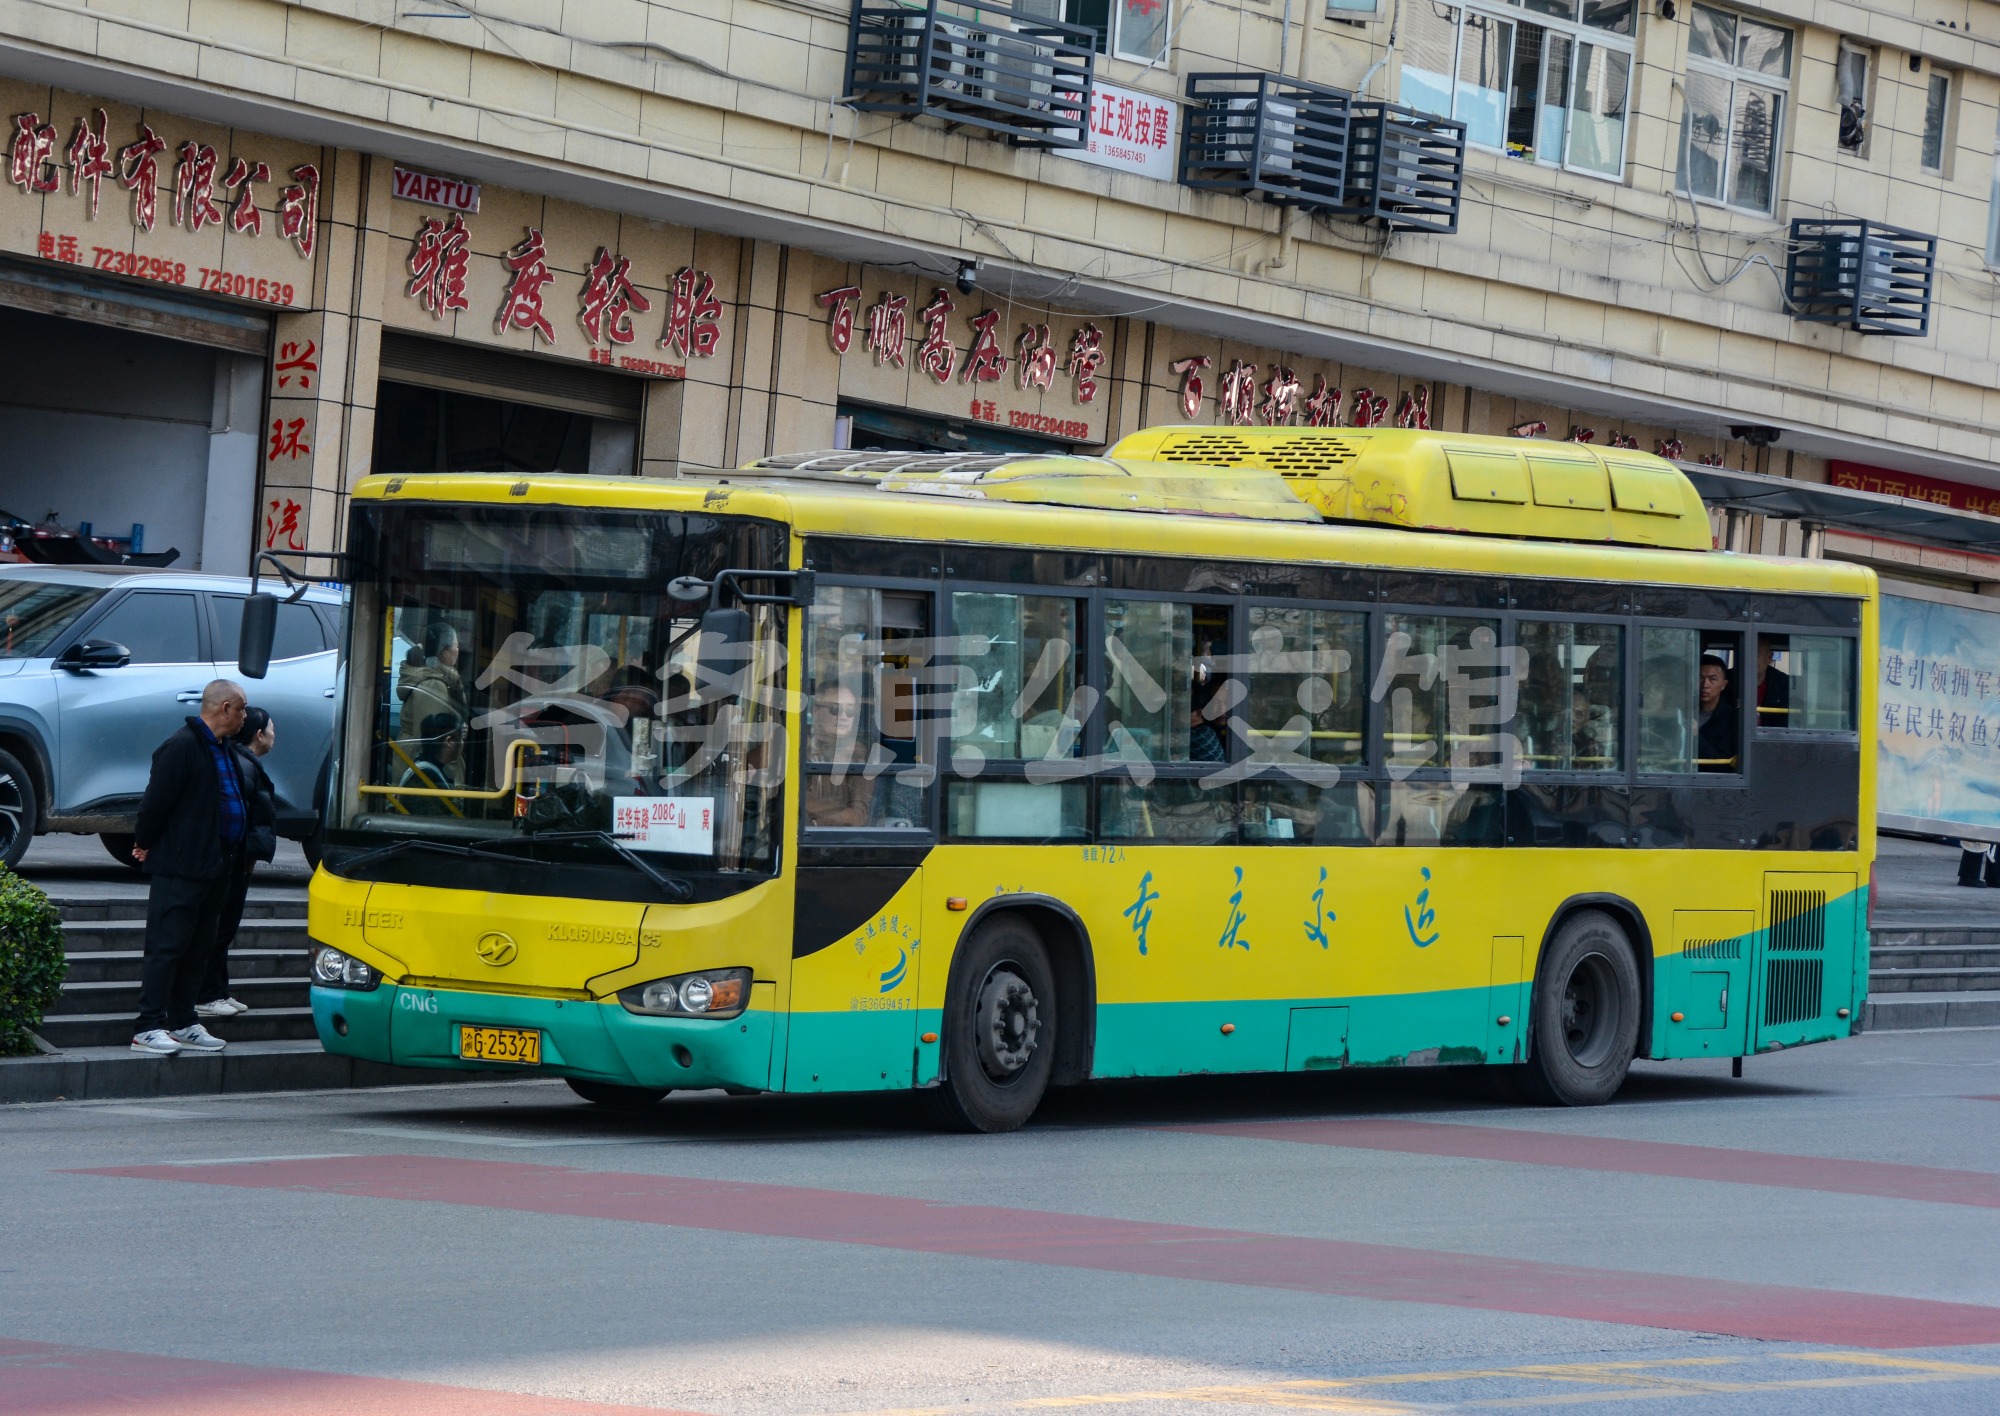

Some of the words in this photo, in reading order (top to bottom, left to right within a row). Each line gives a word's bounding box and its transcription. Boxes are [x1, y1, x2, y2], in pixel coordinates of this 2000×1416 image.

[9, 108, 320, 261] 配件有限公司
[394, 170, 473, 210] YARTU
[92, 246, 187, 285] 72302958
[199, 267, 294, 306] 72301639
[407, 212, 724, 359] 雅度轮胎
[817, 286, 1106, 406] 百顺高压油管
[266, 339, 318, 551] 兴环汽
[1008, 410, 1089, 439] 13012304888
[1879, 654, 2000, 701] 建引领拥军
[652, 802, 675, 821] 208C
[343, 908, 404, 929] HIGER
[1123, 866, 1440, 957] 重庆交运
[400, 993, 438, 1014] CNG
